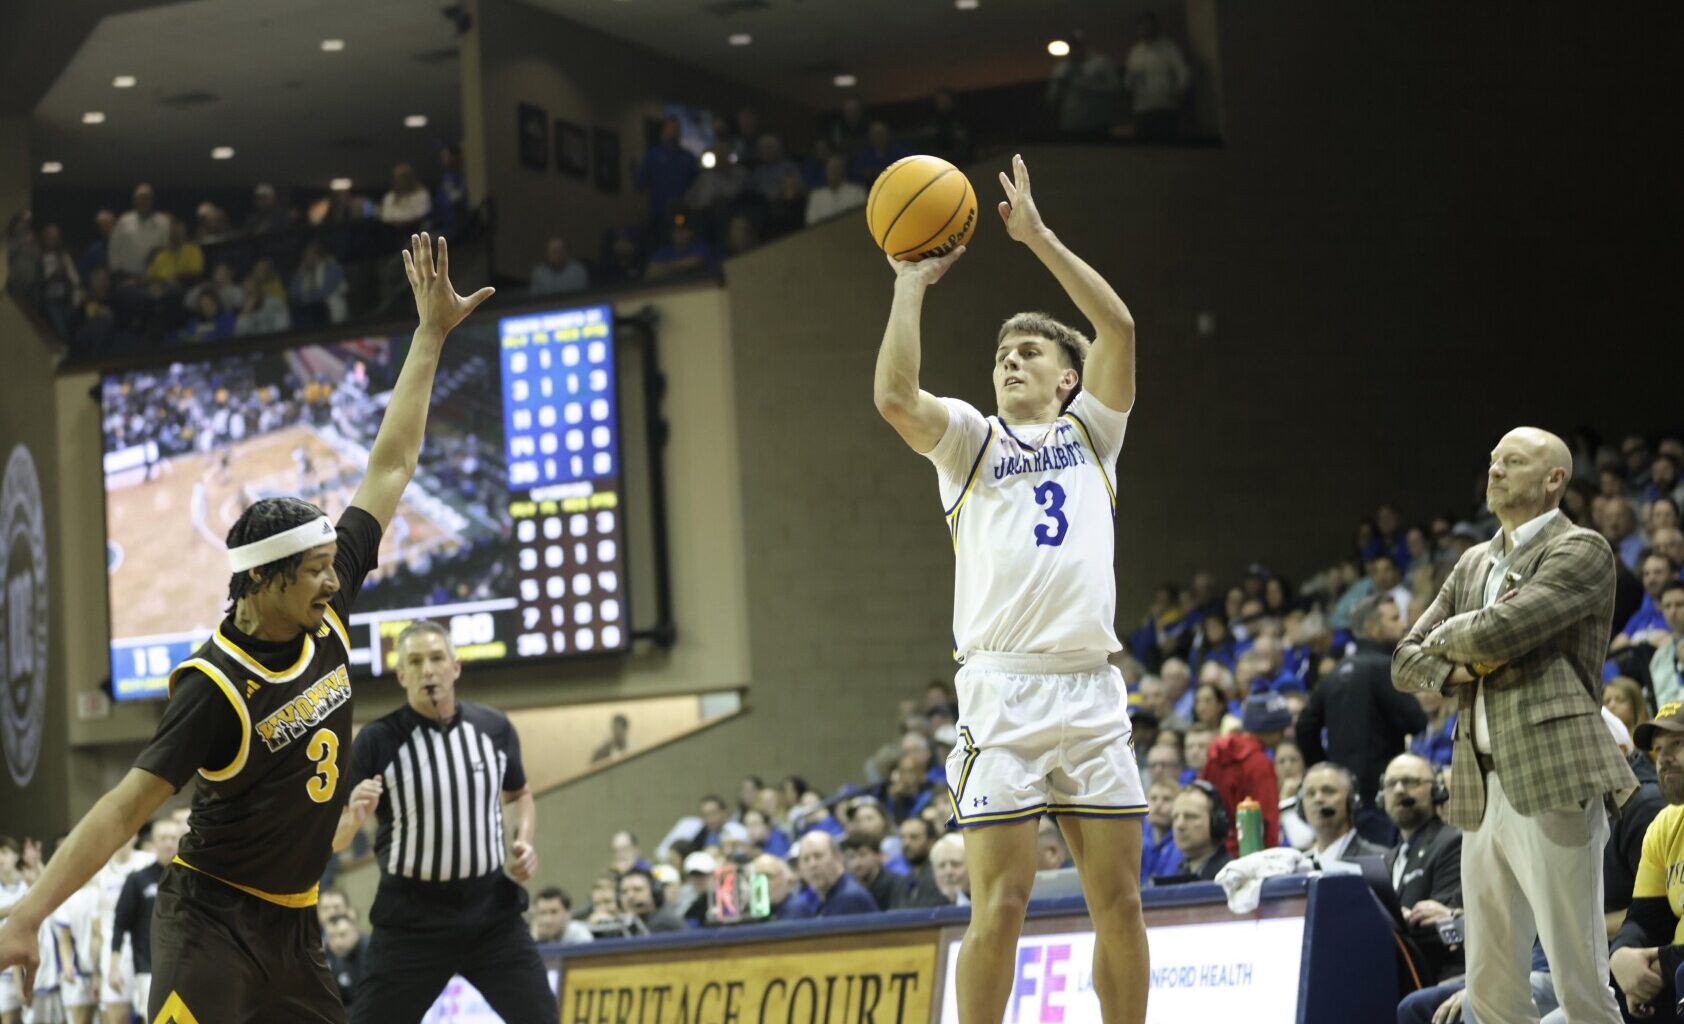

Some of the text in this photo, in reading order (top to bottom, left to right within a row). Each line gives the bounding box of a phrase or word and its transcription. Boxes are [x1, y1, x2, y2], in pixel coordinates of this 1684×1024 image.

[1034, 481, 1068, 546] 3
[255, 663, 352, 753] WYOMING
[306, 728, 339, 803] 3
[758, 971, 919, 1024] COURT
[1199, 962, 1254, 988] HEALTH
